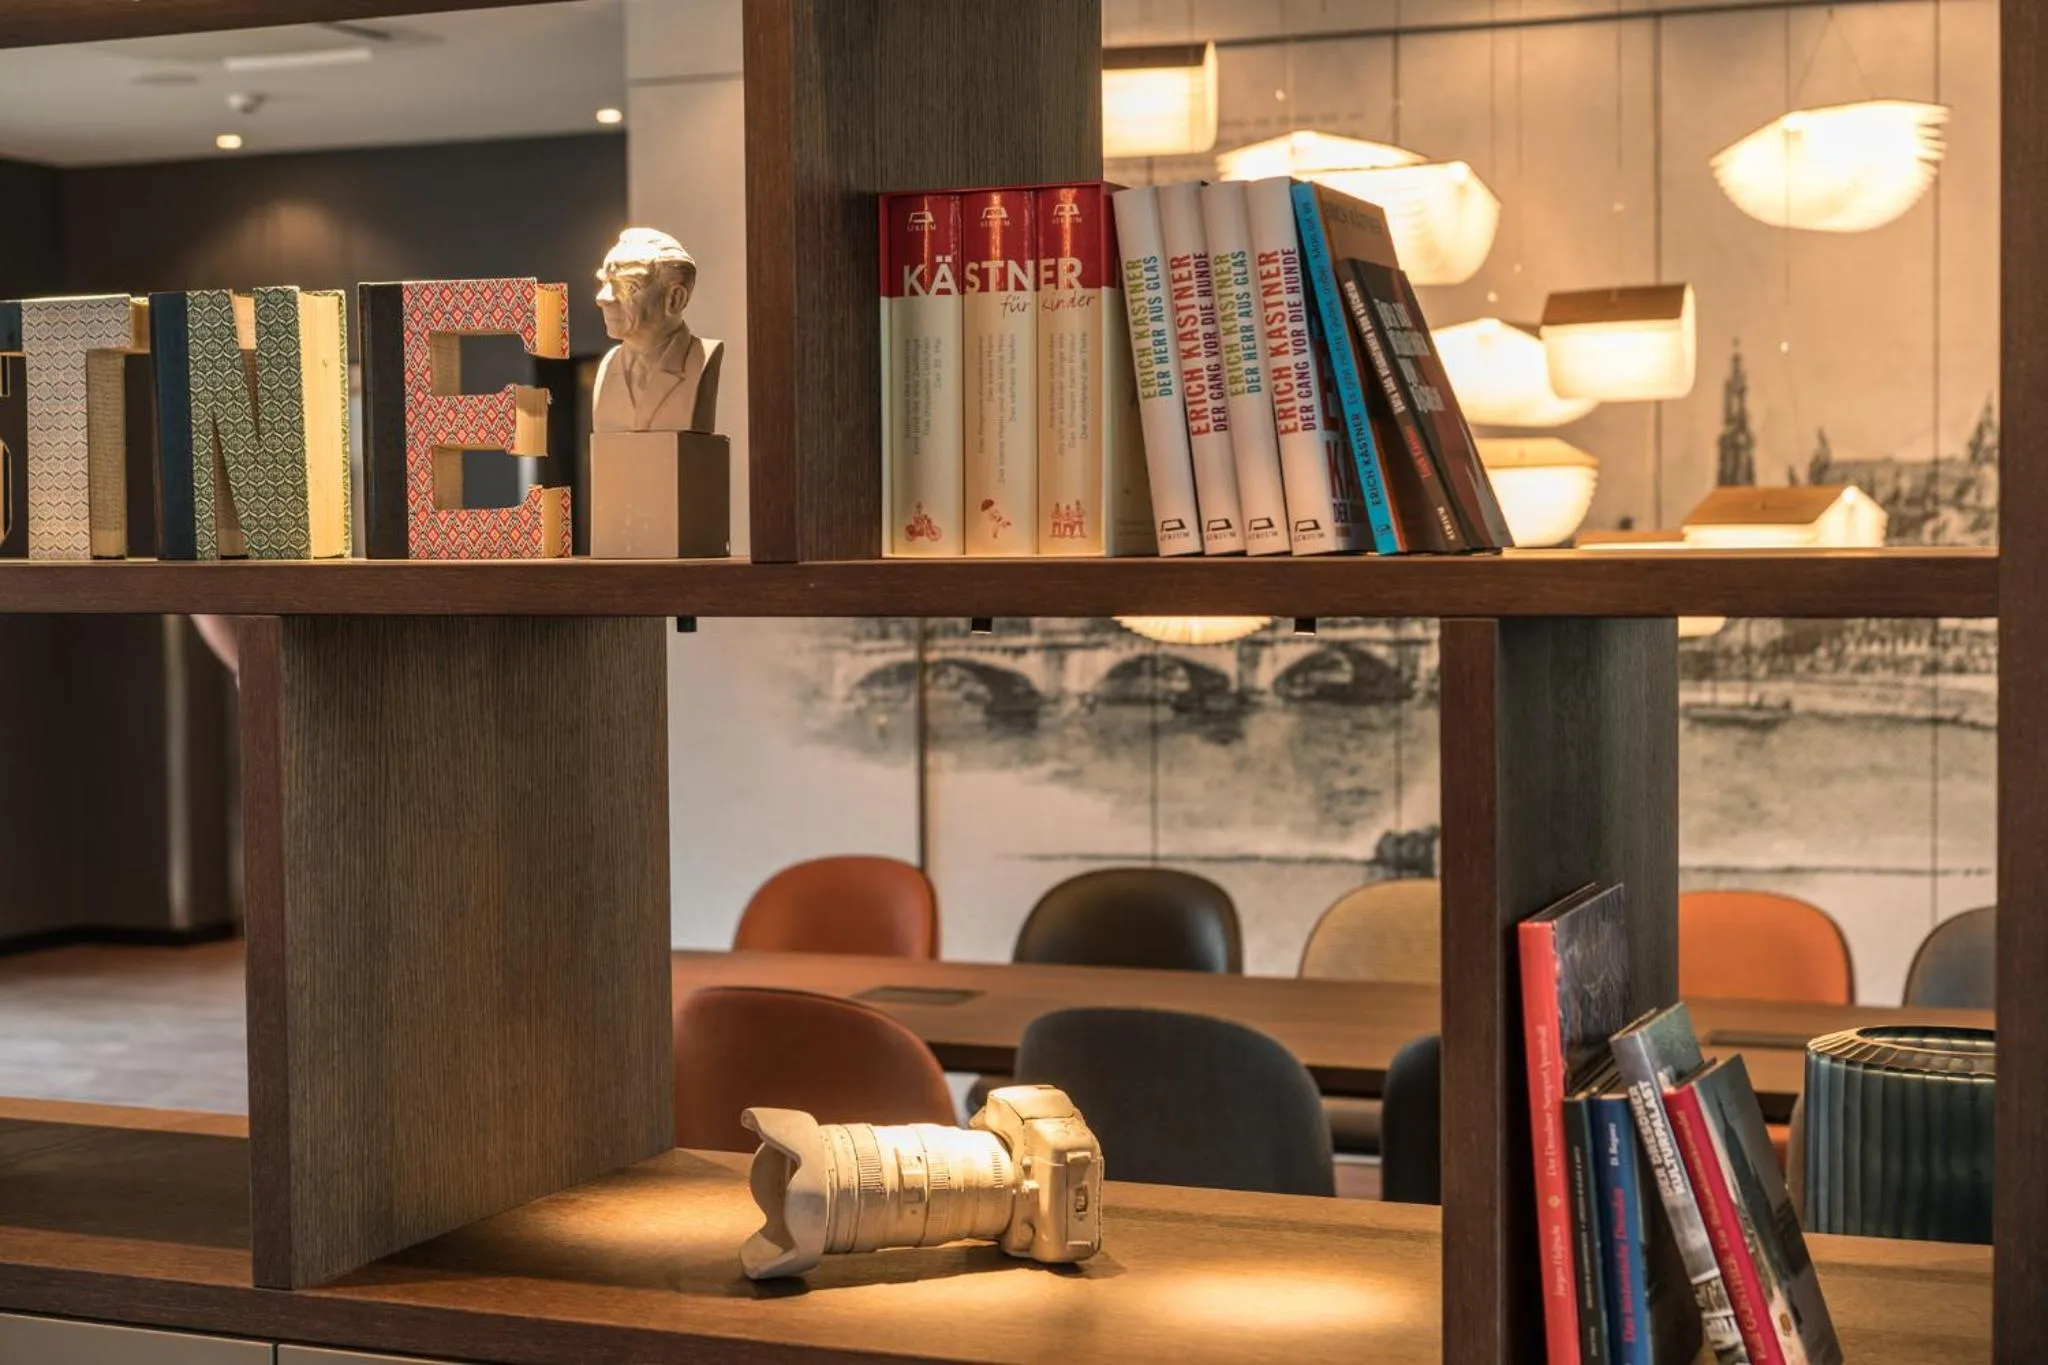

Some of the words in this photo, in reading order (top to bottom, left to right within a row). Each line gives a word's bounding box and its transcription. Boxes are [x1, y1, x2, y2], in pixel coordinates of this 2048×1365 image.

[902, 255, 1083, 297] KÄSTNER
[1144, 256, 1161, 291] GLAS
[1196, 251, 1213, 298] HUNDE
[1232, 250, 1249, 286] GLAS
[1283, 249, 1300, 295] HUNDE
[1000, 294, 1031, 319] für
[1149, 297, 1164, 323] AUS
[1201, 303, 1214, 326] DIE
[1238, 292, 1252, 318] AUS
[1290, 300, 1303, 323] DIE
[1152, 329, 1167, 364] HERR
[1204, 332, 1220, 357] VOR
[1240, 325, 1256, 361] HERR
[1292, 329, 1307, 356] VOR
[1137, 348, 1156, 400] ERICH
[1158, 371, 1173, 397] DER
[1206, 364, 1223, 401] GANG
[1225, 344, 1245, 397] ERICH
[1246, 367, 1261, 394] DER
[1296, 362, 1312, 399] GANG
[1184, 367, 1209, 437] ERICH
[1274, 365, 1299, 436] ERICH
[1301, 405, 1315, 431] DER
[1212, 406, 1228, 432] DER
[1367, 469, 1381, 506] ERICH
[1638, 1081, 1686, 1196] KULTURPALAST
[1655, 1167, 1673, 1198] DER
